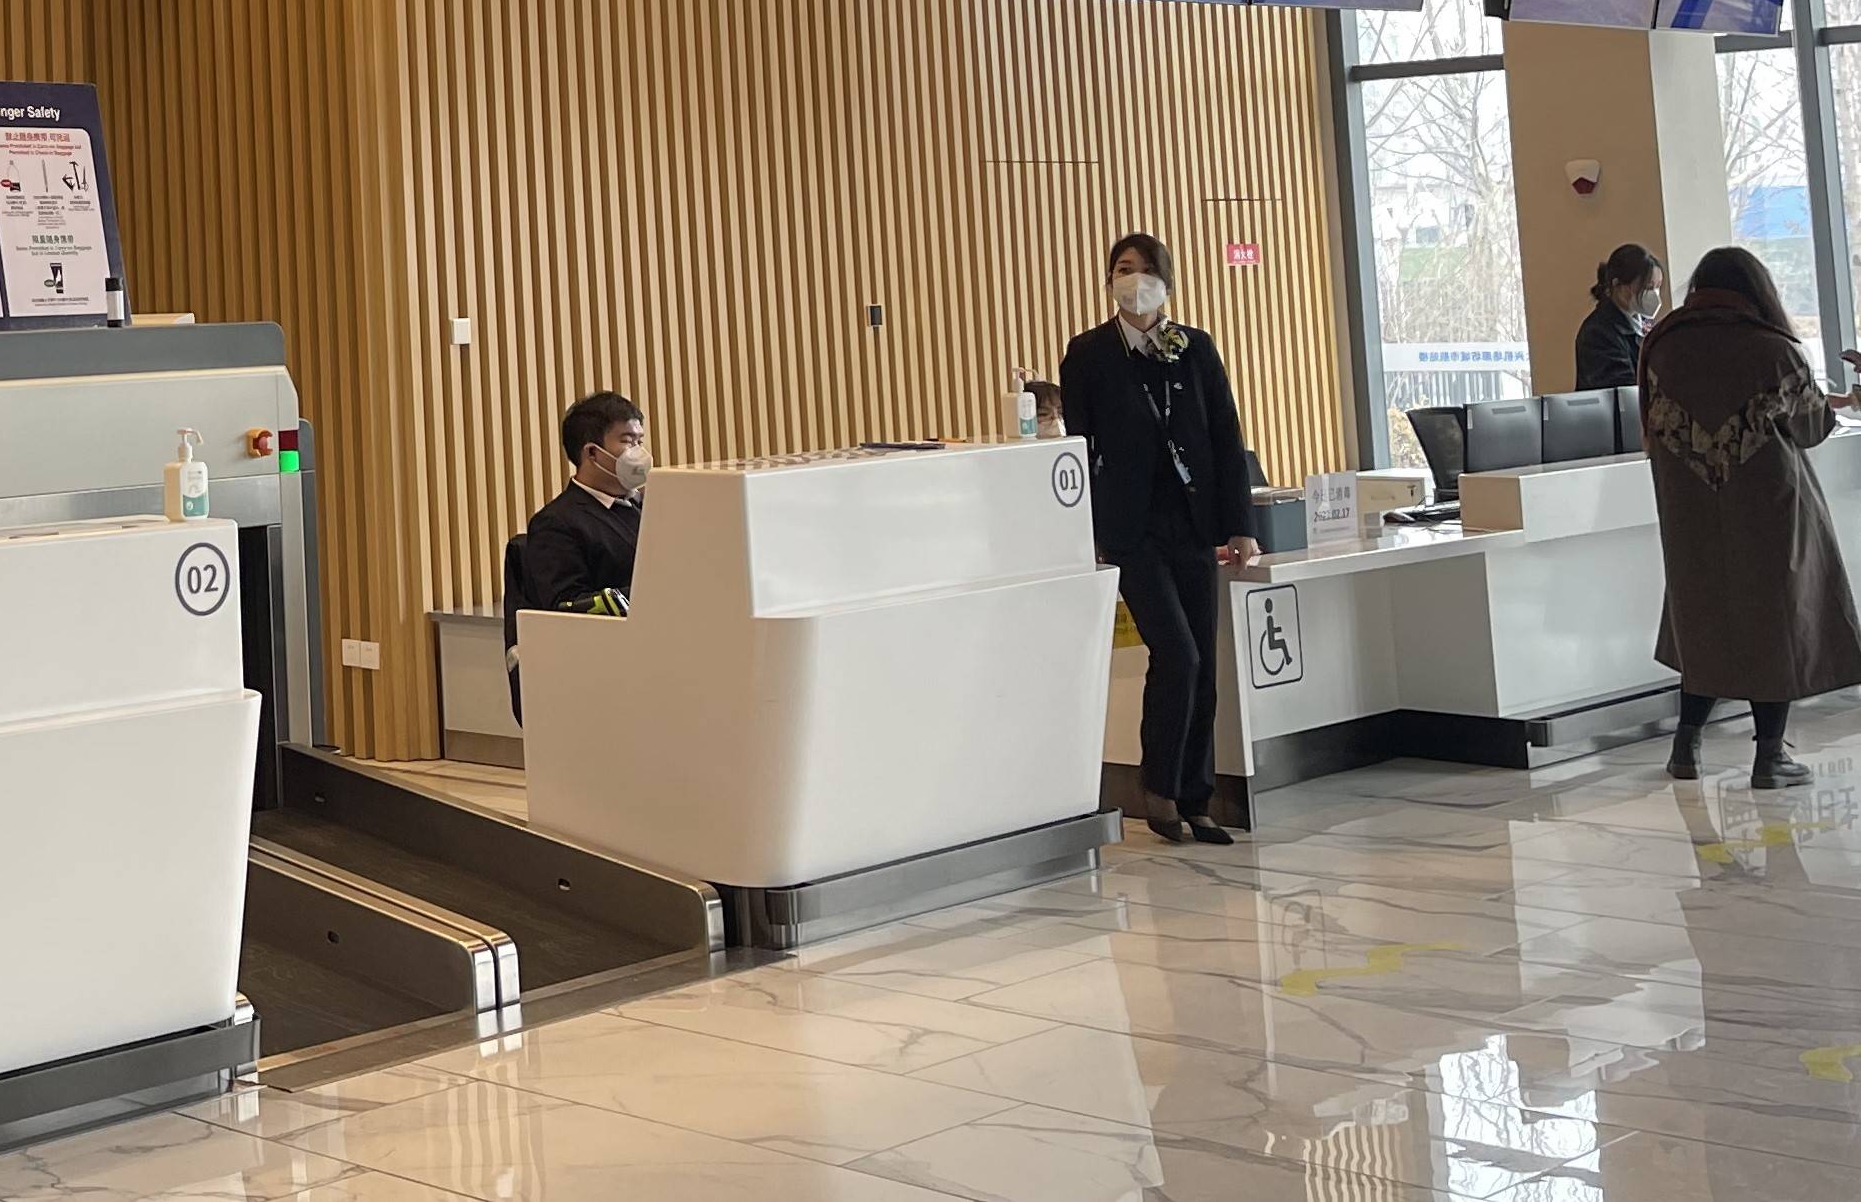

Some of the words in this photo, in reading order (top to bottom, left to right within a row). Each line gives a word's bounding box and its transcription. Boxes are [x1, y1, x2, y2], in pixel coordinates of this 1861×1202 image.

[27, 106, 61, 121] Safety
[1059, 469, 1078, 491] 01
[187, 564, 218, 595] 02
